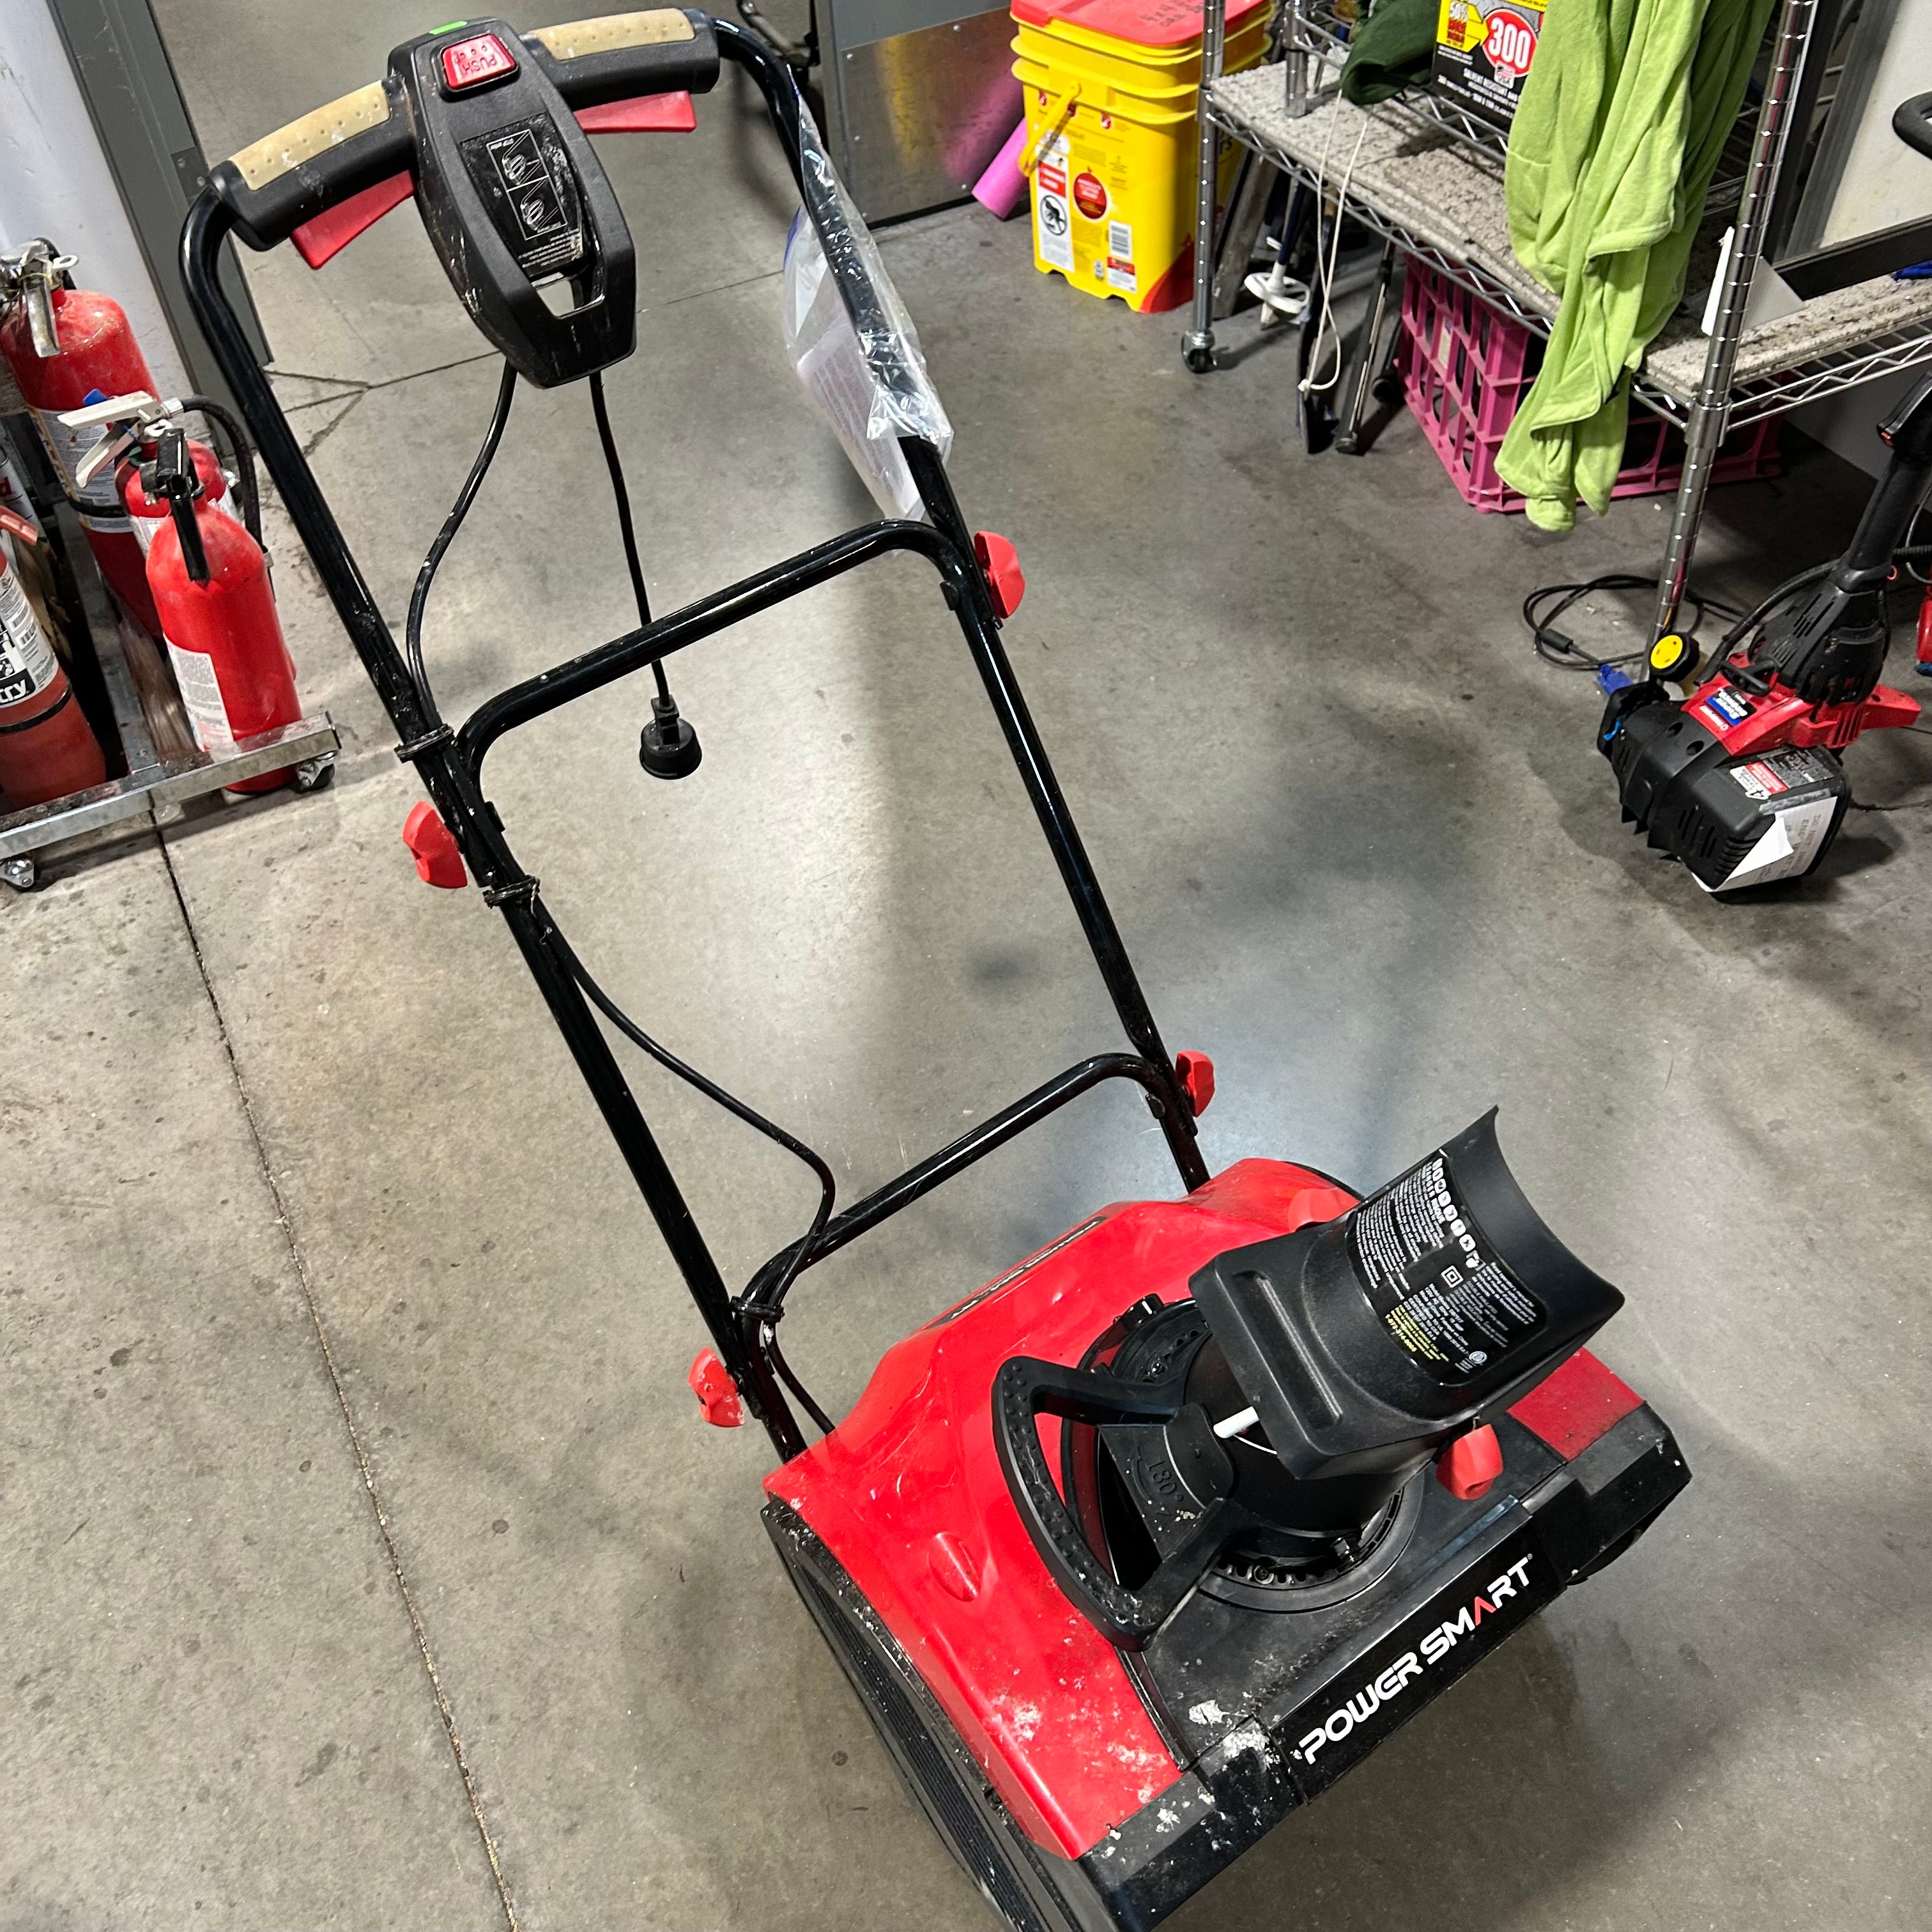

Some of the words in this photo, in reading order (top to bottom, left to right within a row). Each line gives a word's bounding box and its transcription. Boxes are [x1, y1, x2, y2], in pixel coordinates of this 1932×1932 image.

[461, 54, 497, 75] PUSH
[1488, 17, 1531, 69] 300
[1299, 1652, 1423, 1764] POWER
[1420, 1557, 1529, 1664] SMART
